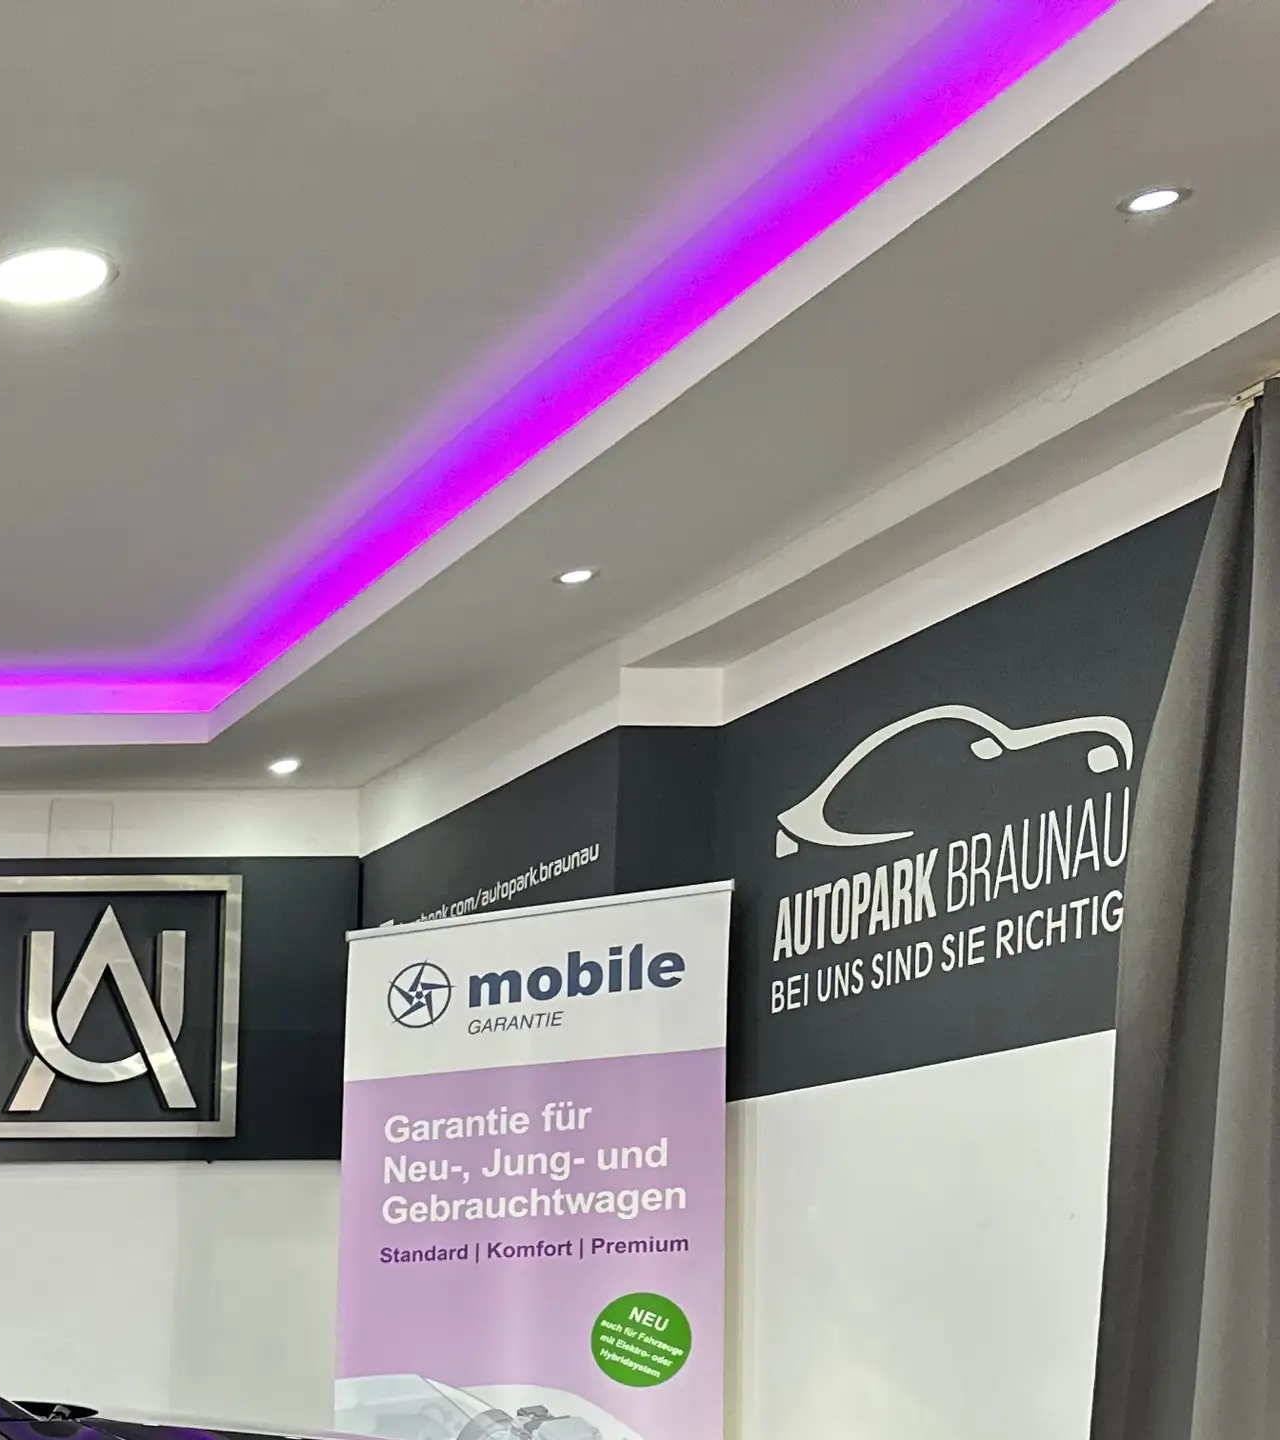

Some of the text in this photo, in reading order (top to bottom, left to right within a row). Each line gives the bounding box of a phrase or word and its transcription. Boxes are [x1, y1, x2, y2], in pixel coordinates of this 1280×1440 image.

[773, 786, 1130, 963] AUTOPARK BRAUNAU
[771, 889, 1124, 1015] BEI UNS SIND SIE RICHTIG
[468, 943, 686, 1009] mobile
[467, 1011, 564, 1035] GARANTIE
[384, 1101, 592, 1144] Garantie für
[383, 1138, 668, 1185] Neu-, Jung- und
[381, 1185, 687, 1225] Gebrauchtwagen
[380, 1243, 469, 1264] Standard
[487, 1240, 573, 1260] Komfort
[590, 1236, 689, 1256] Premium
[600, 1319, 684, 1356] auch für Fahrzeuge
[628, 1306, 670, 1332] NEU
[599, 1334, 674, 1367] mit Elektro- oder
[599, 1348, 661, 1378] Hybridsystem
